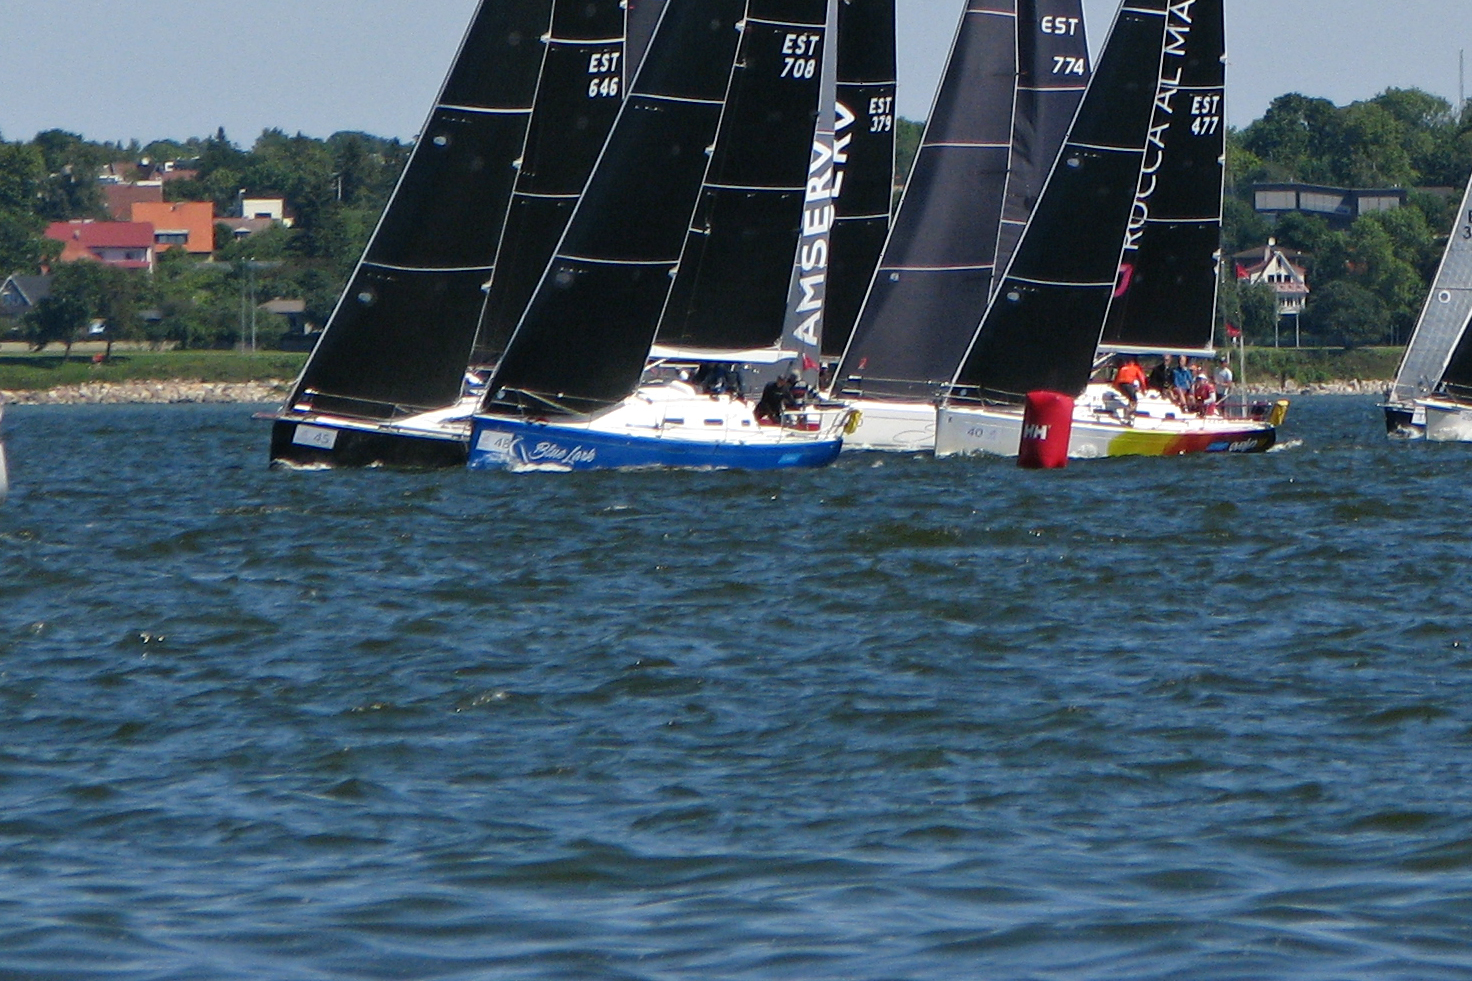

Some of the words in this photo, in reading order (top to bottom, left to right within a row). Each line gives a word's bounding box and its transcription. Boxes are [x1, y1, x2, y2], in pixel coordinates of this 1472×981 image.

[1041, 15, 1079, 35] EST
[782, 33, 820, 56] EST
[588, 51, 621, 74] EST
[780, 58, 816, 79] 708
[1052, 56, 1085, 75] 774
[588, 76, 619, 98] 646
[1156, 67, 1182, 114] AL
[869, 96, 893, 115] EST
[1191, 95, 1221, 115] EST
[870, 115, 892, 132] 379
[1191, 116, 1219, 136] 477
[793, 140, 832, 346] AMSERV
[313, 432, 330, 445] 45
[966, 427, 984, 438] 40
[528, 441, 568, 460] Blue
